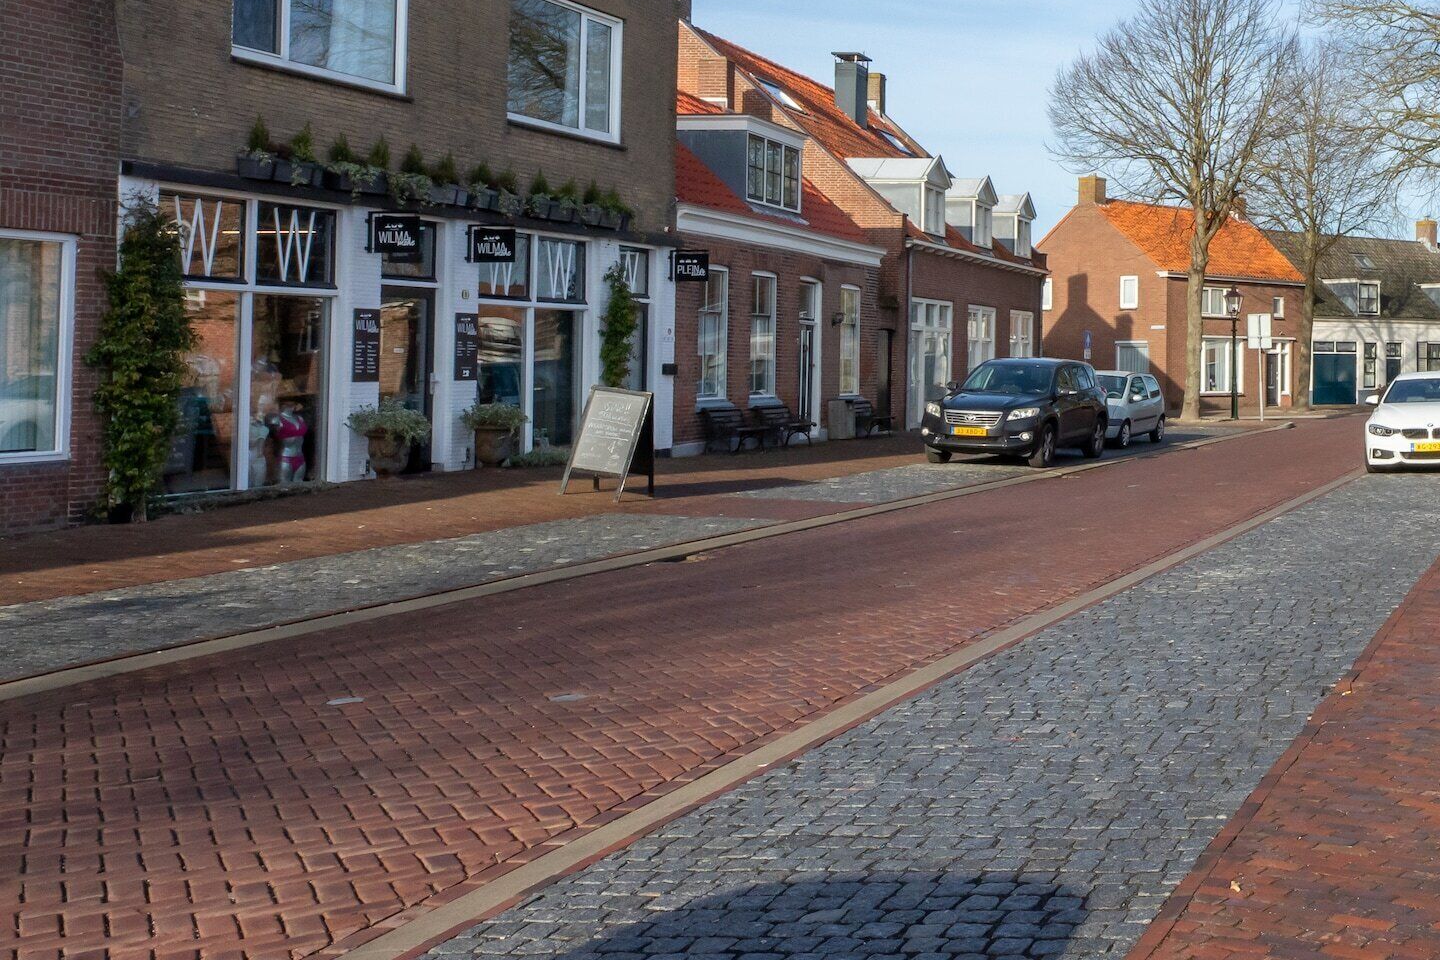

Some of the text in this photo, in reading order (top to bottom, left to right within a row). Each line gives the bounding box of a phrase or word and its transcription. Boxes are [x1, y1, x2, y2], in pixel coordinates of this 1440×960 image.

[378, 230, 409, 244] WILMA
[273, 207, 316, 282] W
[477, 242, 506, 254] WILMA
[677, 264, 700, 275] PLEIN
